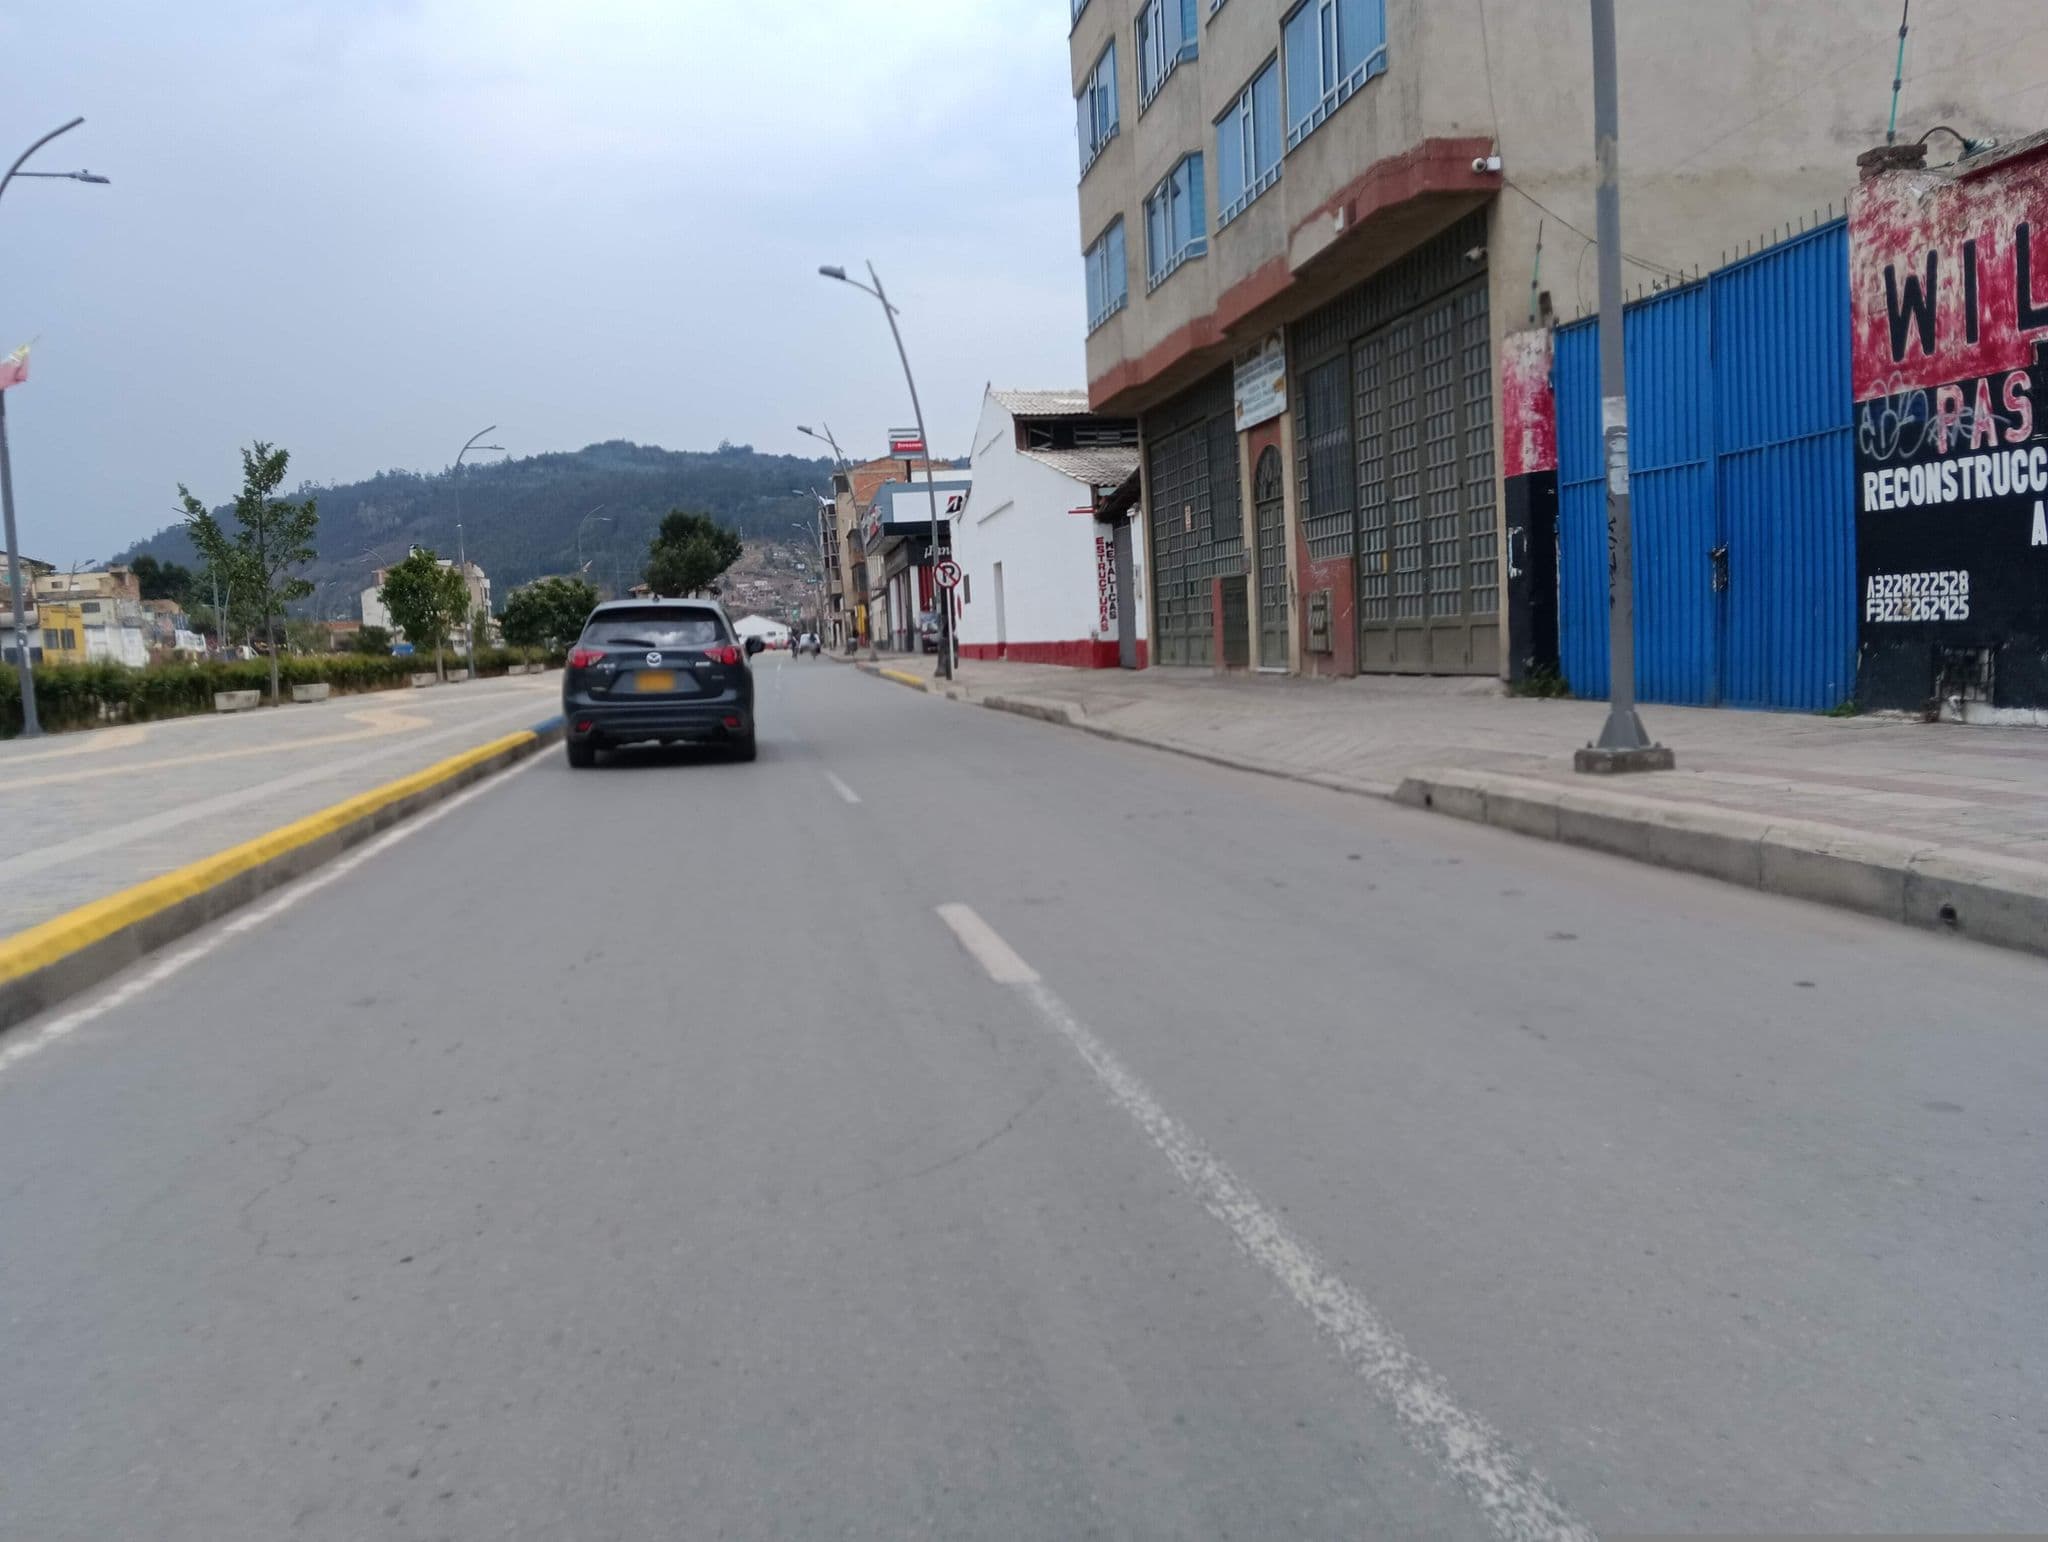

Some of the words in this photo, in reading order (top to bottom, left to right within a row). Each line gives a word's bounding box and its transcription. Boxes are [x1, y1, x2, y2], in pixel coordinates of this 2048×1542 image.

[1884, 221, 2048, 363] WIL
[1936, 370, 2033, 454] PAS
[1863, 446, 2048, 512] RECONSTRUCC
[2031, 500, 2048, 546] A
[1095, 536, 1109, 632] ESTRUCTURAS
[1105, 541, 1117, 619] METALICAS
